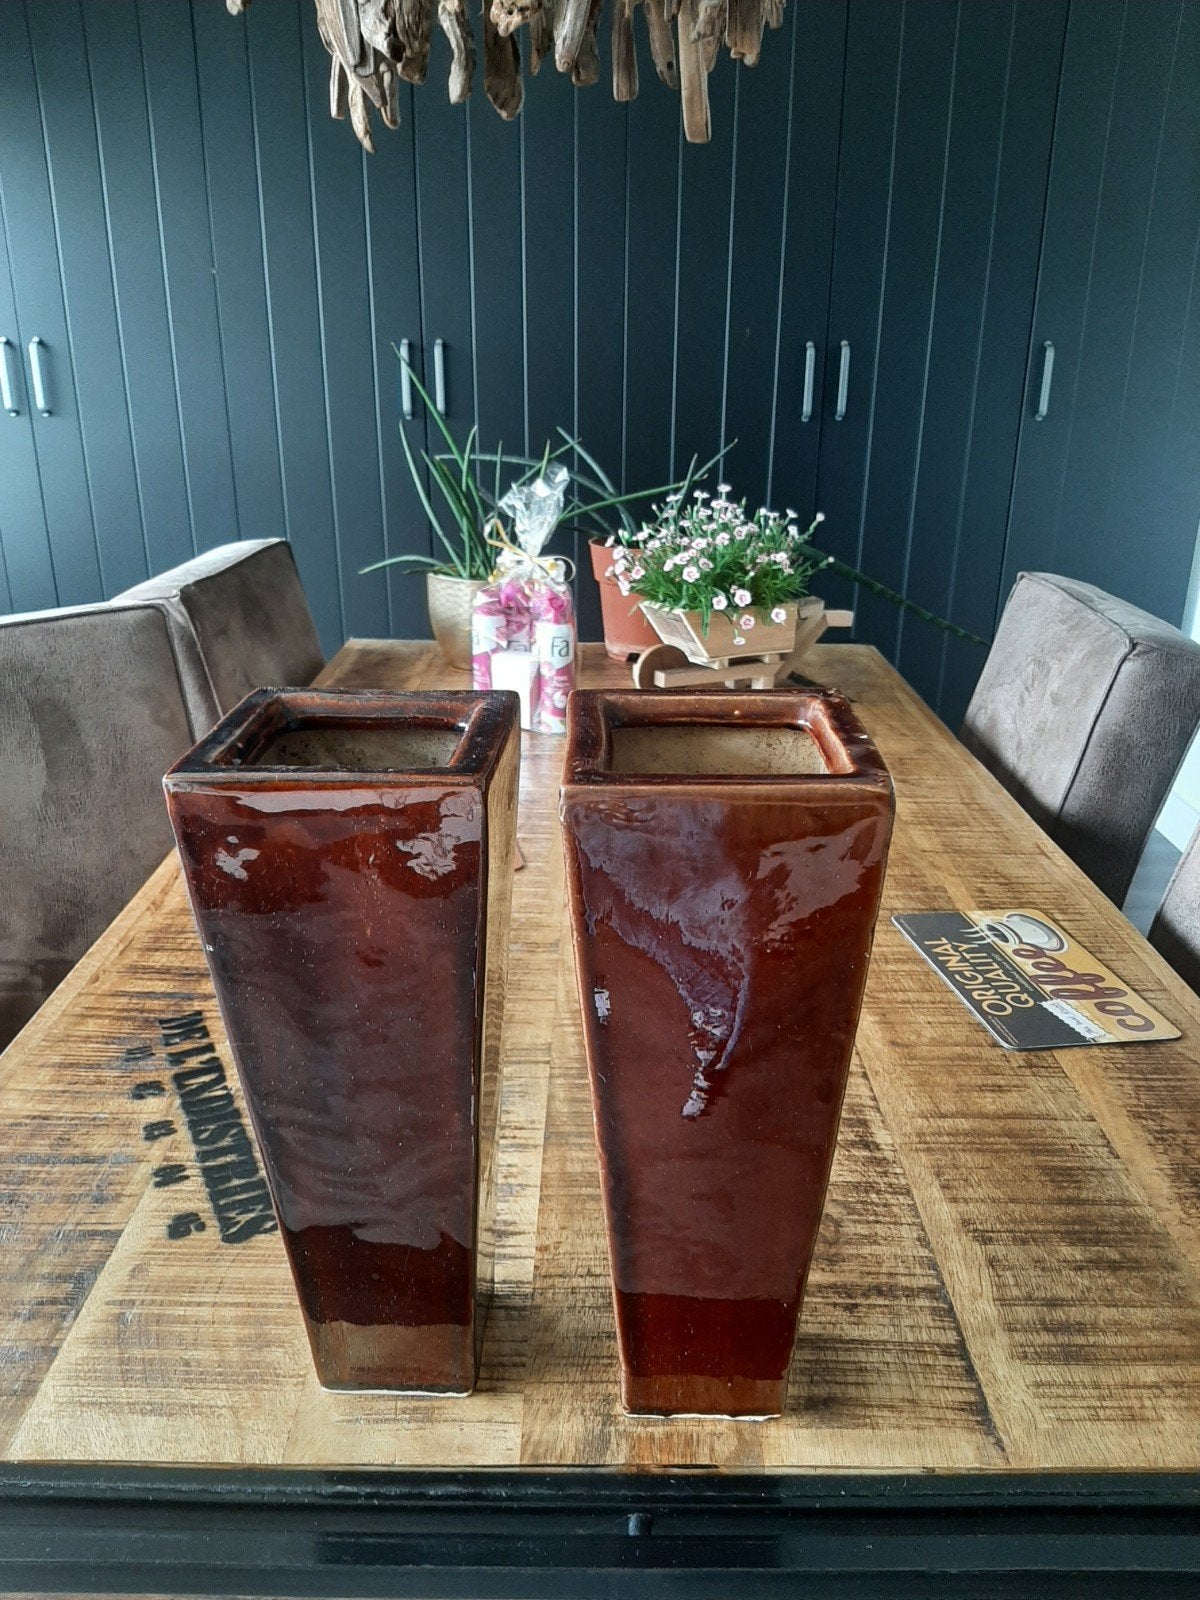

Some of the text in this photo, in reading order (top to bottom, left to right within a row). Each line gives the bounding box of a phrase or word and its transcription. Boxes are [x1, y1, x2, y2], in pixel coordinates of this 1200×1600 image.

[551, 636, 570, 658] Fa
[923, 937, 1013, 1016] ORIGINAL
[952, 941, 1035, 1008] QUALITY
